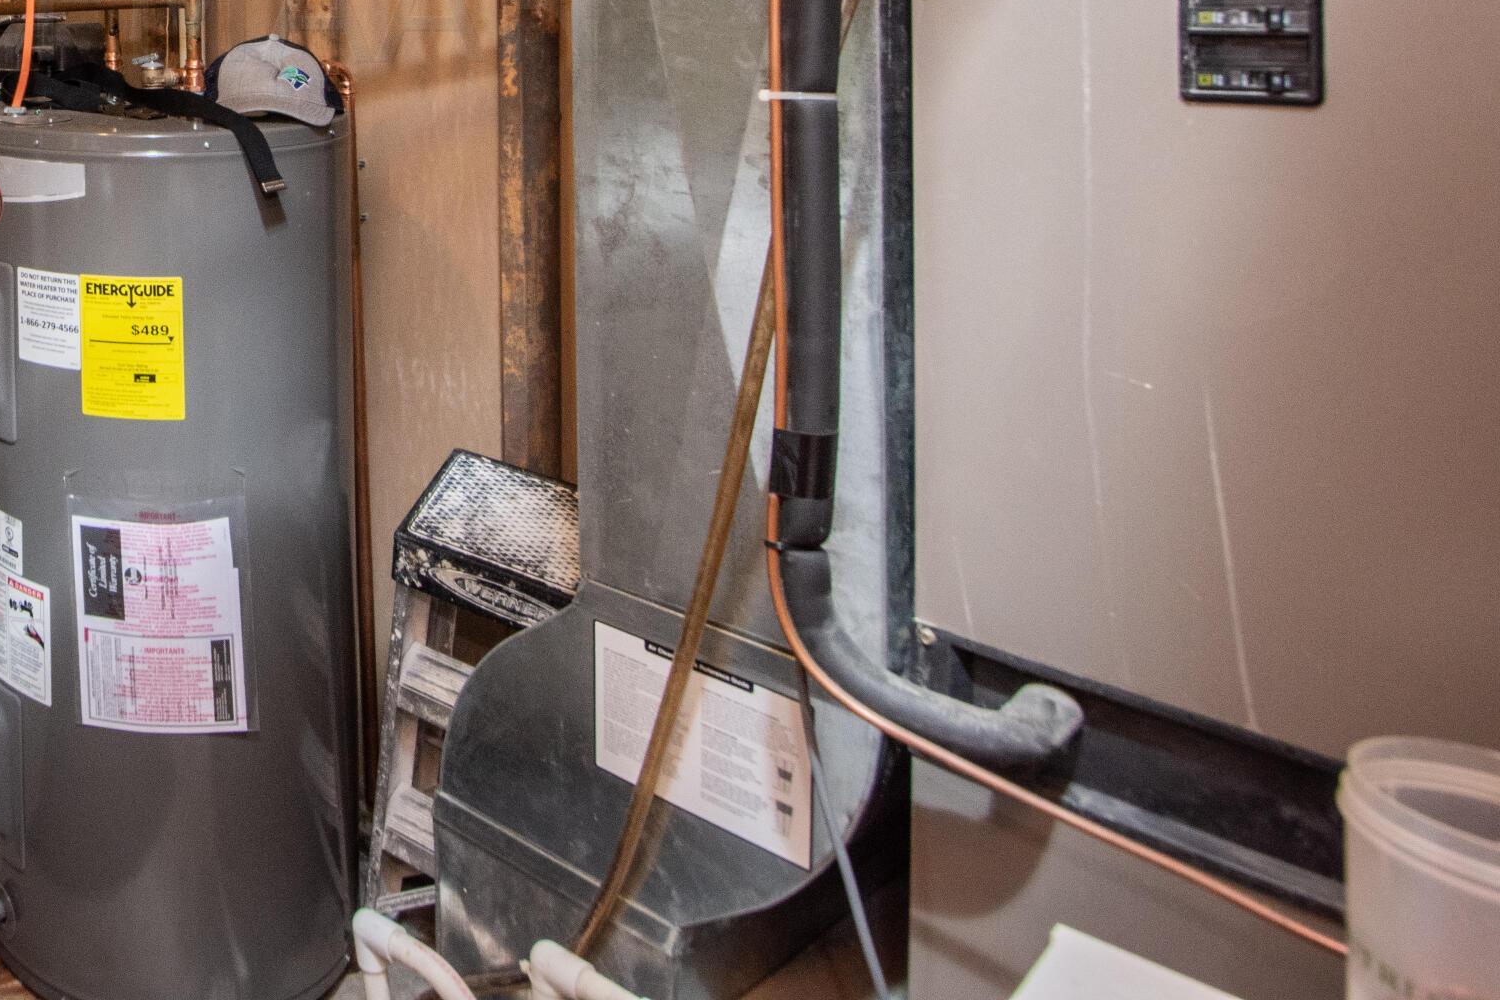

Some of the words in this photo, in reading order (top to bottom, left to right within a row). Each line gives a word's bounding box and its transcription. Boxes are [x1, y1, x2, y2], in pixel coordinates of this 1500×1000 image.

[29, 273, 40, 281] NOT
[40, 275, 63, 284] RETURN
[64, 277, 77, 285] THIS
[20, 281, 36, 289] WATER
[36, 283, 58, 292] HEATER
[66, 286, 78, 295] THE
[86, 283, 175, 299] ENERGYGUIDE
[21, 290, 37, 299] PLACE
[45, 293, 76, 304] PURCHASE
[20, 316, 79, 334] 1-866-279-4566
[131, 324, 169, 336] $489
[86, 557, 99, 598] Certificate
[14, 583, 44, 600] DANGER
